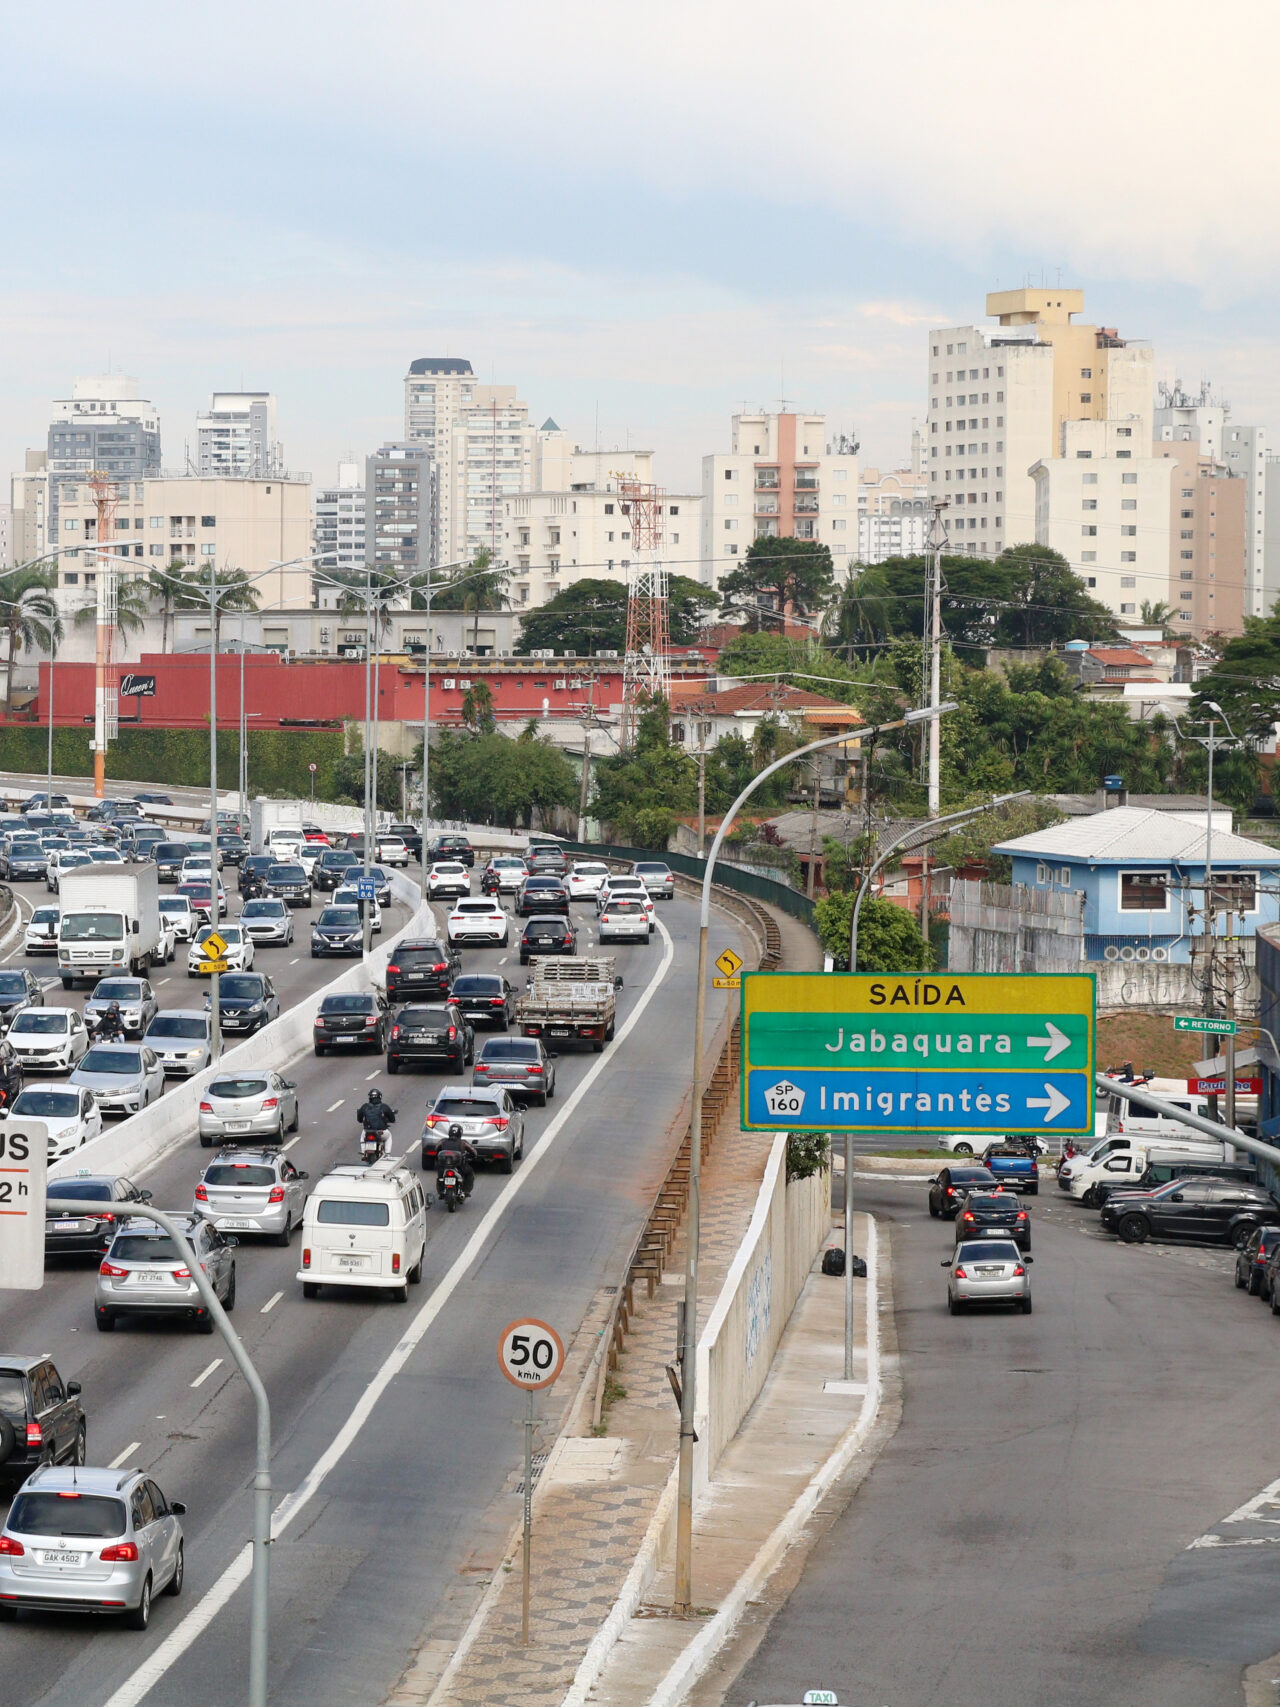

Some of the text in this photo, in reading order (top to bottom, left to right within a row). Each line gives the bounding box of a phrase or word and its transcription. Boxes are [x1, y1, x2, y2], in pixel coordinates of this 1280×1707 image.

[869, 978, 966, 1006] SAÍDA
[1191, 1021, 1232, 1031] RETORNO
[825, 1027, 1012, 1058] Jabaquara
[775, 1085, 794, 1096] SP
[1197, 1080, 1251, 1089] Pauliho
[770, 1098, 800, 1112] 160
[820, 1085, 1012, 1116] Imigrantes
[509, 1335, 554, 1369] 50
[517, 1369, 541, 1381] km/h
[808, 1692, 833, 1703] TAXI
